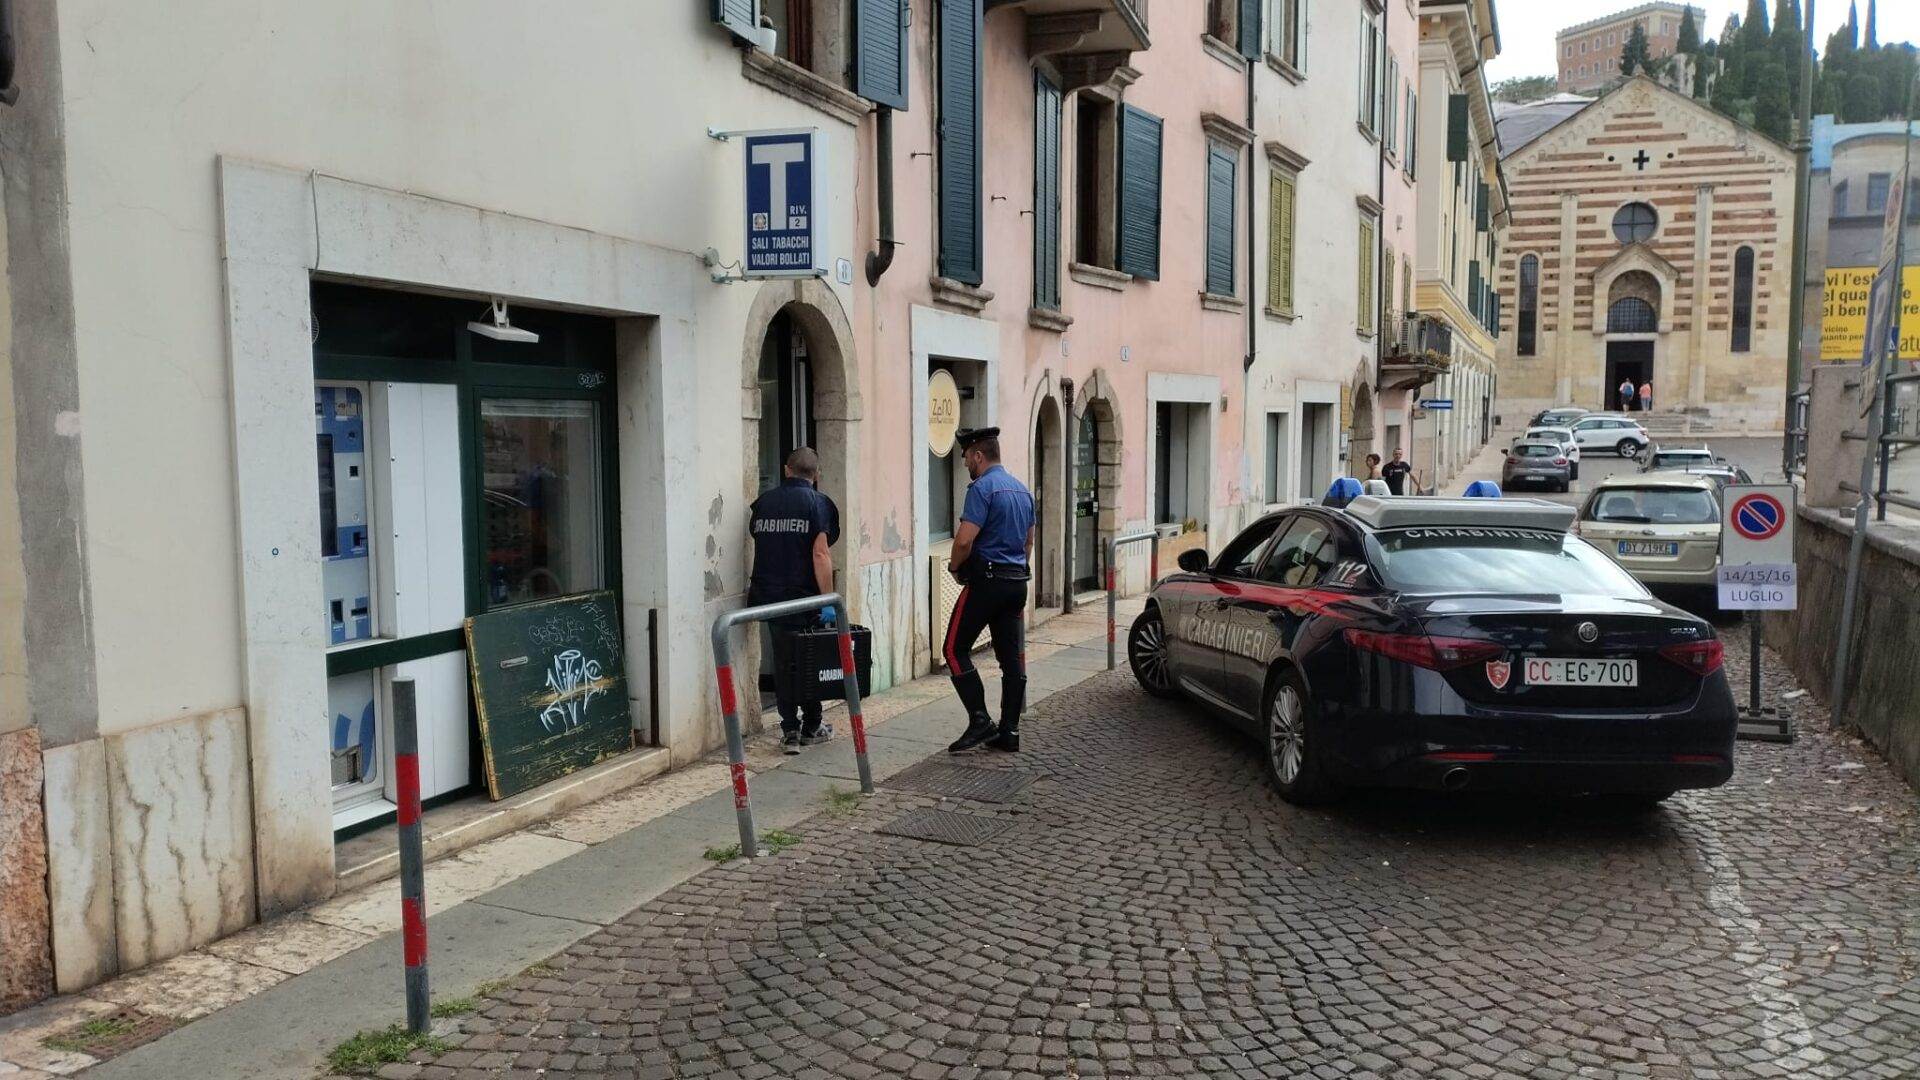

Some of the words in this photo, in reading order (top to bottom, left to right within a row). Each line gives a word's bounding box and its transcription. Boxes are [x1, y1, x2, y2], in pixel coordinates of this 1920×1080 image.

[752, 142, 804, 230] T
[789, 205, 807, 215] RIV.
[794, 218, 801, 227] 2
[752, 237, 769, 249] SALI
[772, 236, 809, 249] TABACCHI
[752, 253, 778, 266] VALORI
[779, 252, 810, 265] BOLLATI
[1335, 560, 1368, 583] 112
[1724, 569, 1791, 582] 14/15/16
[1731, 589, 1784, 602] LUGLIO
[1187, 617, 1269, 661] CARABINIERI
[1529, 661, 1552, 681] CC
[1565, 662, 1588, 682] EG
[1597, 662, 1633, 683] 700
